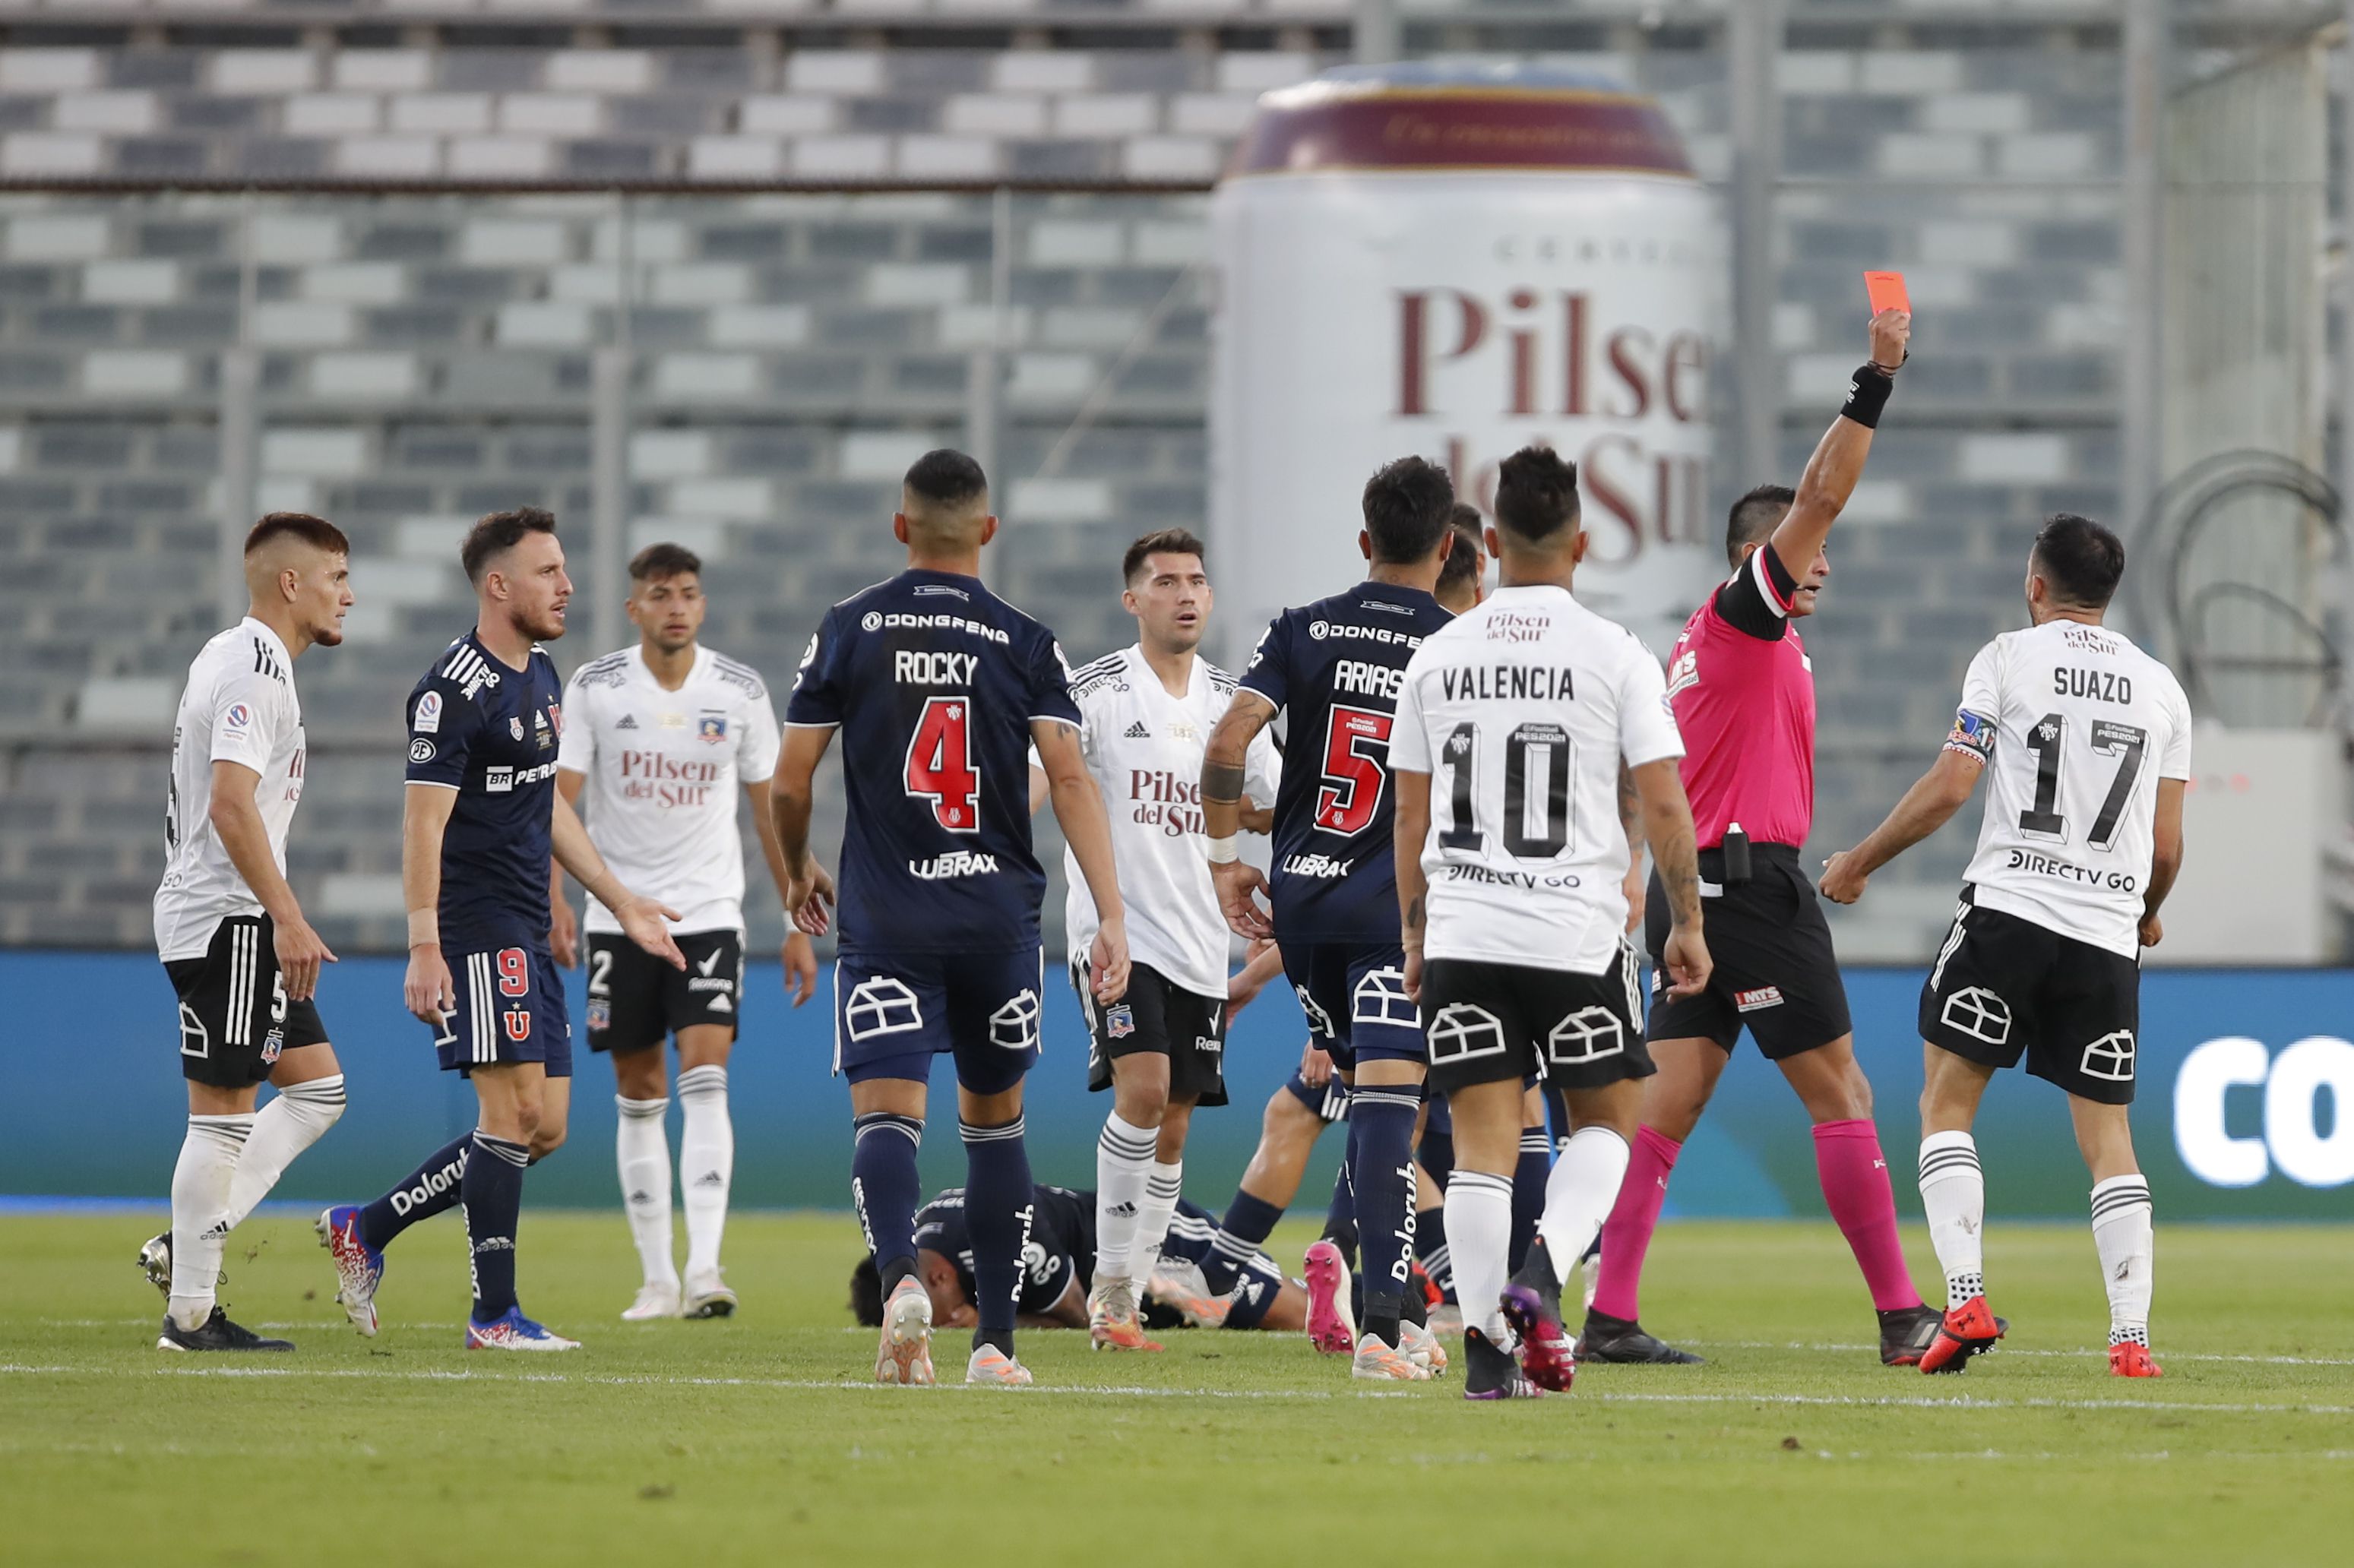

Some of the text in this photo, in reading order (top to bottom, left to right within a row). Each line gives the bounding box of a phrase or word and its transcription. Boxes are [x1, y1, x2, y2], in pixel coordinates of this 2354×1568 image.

[1394, 283, 1707, 422] Pilse
[1580, 430, 1705, 571] Su
[884, 614, 1010, 645] DONGFENG
[1330, 624, 1423, 649] DONGFE
[1486, 613, 1550, 629] Pilsen
[1487, 628, 1546, 643] del Sur
[460, 662, 492, 701] DIRECTV
[485, 672, 501, 688] GO
[894, 650, 979, 686] ROCKY
[1333, 659, 1405, 700] ARIAS
[1442, 665, 1574, 701] VALENCIA
[1082, 675, 1123, 698] DIRECTV
[1112, 683, 1131, 693] GO
[1213, 682, 1234, 697] DIR
[2054, 666, 2131, 706] SUAZO
[1514, 731, 1566, 742] PES2021
[2096, 729, 2140, 744] PES2021
[489, 774, 510, 785] BR
[621, 750, 717, 782] Pilsen
[902, 696, 981, 833] 4
[1312, 703, 1398, 838] 5
[625, 779, 712, 808] del Sur
[1130, 769, 1201, 806] Pilse
[1438, 722, 1578, 863] 10
[2019, 713, 2151, 852] 17
[1133, 803, 1163, 826] del
[909, 852, 1000, 880] LUBRAX
[1448, 864, 1580, 889] DIRECTV GO
[2007, 849, 2135, 892] DIRECTV GO
[497, 947, 530, 997] 9
[589, 950, 613, 994] 2
[271, 969, 287, 1024] 5
[1743, 986, 1780, 1003] MTS
[503, 1010, 530, 1042] U
[2173, 1035, 2354, 1189] CO
[1391, 1161, 1417, 1284] Dolorub
